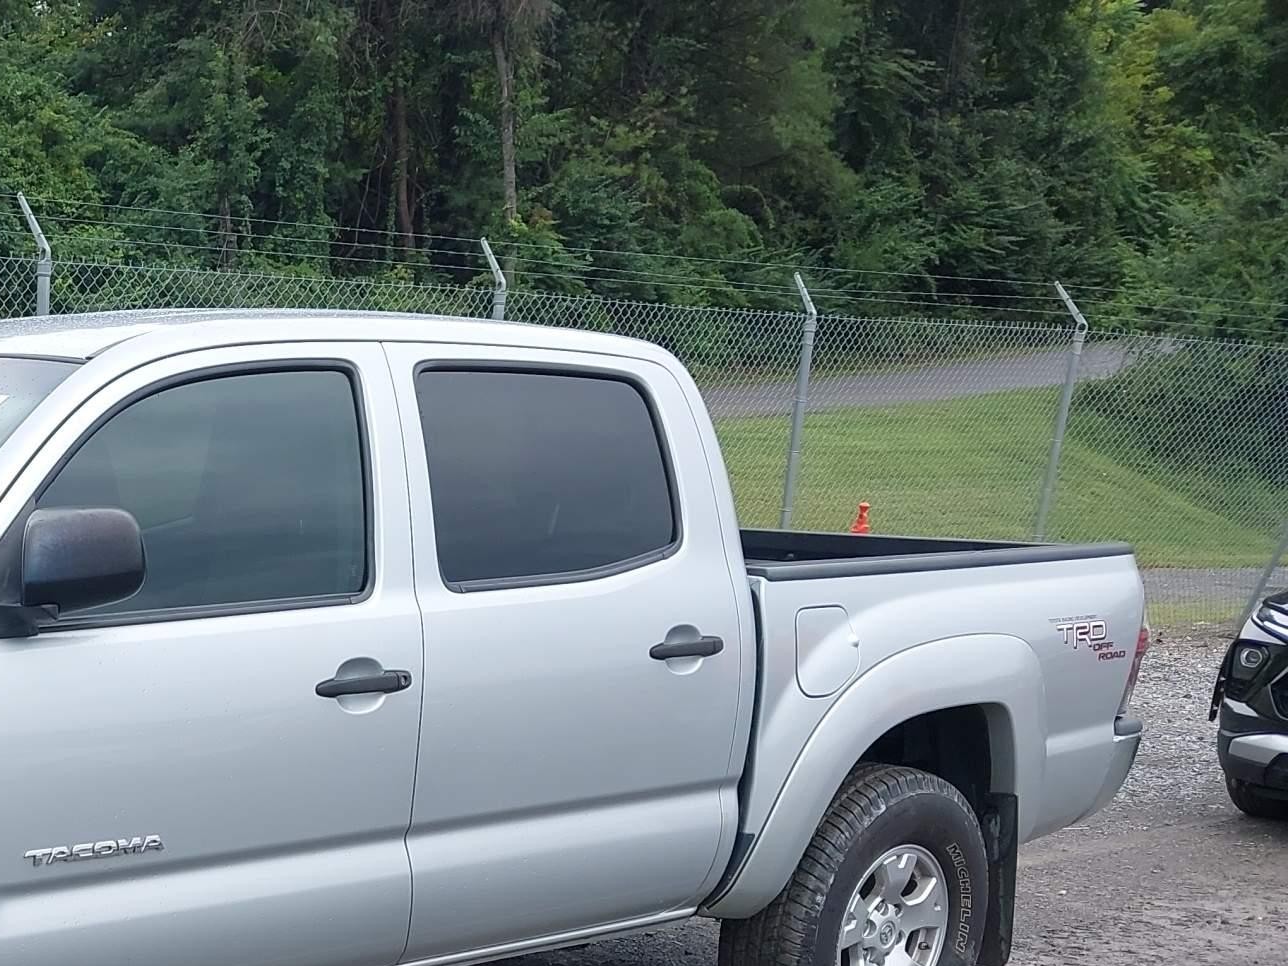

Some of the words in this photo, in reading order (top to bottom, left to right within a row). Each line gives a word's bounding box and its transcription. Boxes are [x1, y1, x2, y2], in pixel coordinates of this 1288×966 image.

[1056, 620, 1107, 649] TRD
[1093, 641, 1114, 651] OFF
[1098, 650, 1126, 661] ROAD
[24, 834, 165, 867] TACOMA
[946, 842, 972, 953] MICHELIN
